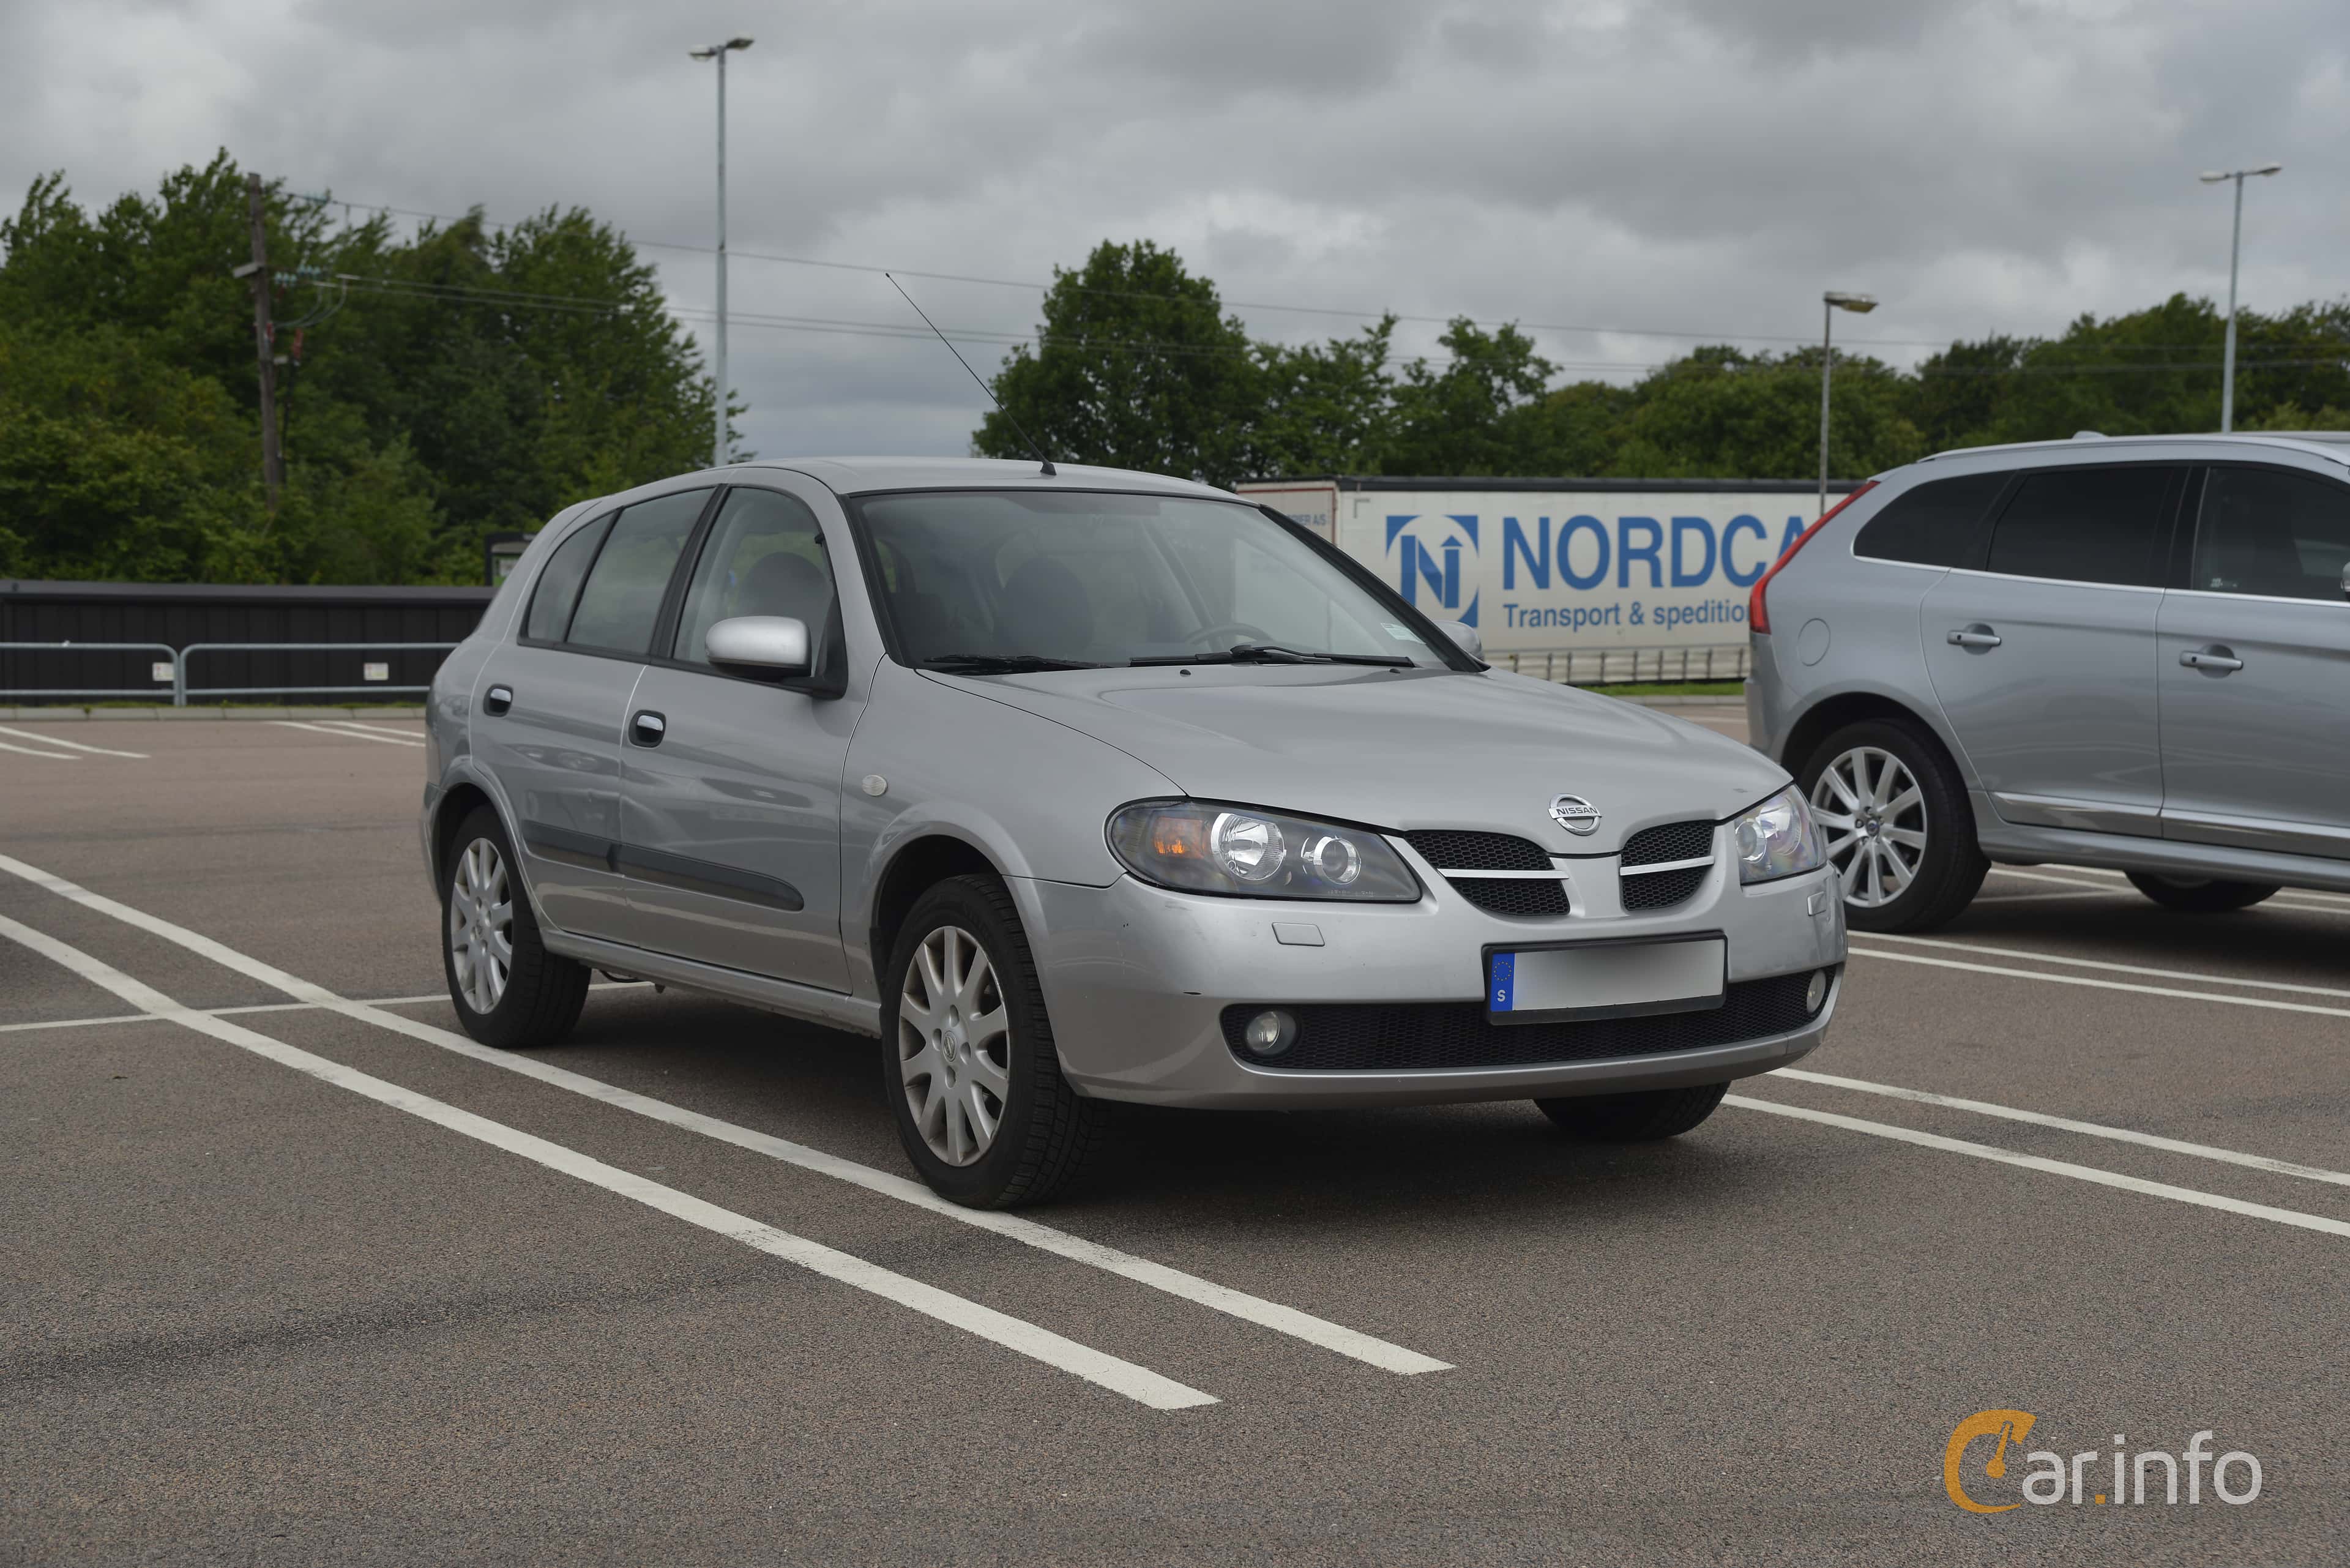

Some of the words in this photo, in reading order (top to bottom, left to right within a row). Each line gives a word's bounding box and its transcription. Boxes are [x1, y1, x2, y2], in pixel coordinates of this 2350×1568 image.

[1503, 603, 1620, 632] Transport
[1629, 602, 1644, 625] &
[1653, 600, 1750, 630] speditio
[1556, 807, 1598, 815] NISSAN
[1497, 989, 1506, 1002] S
